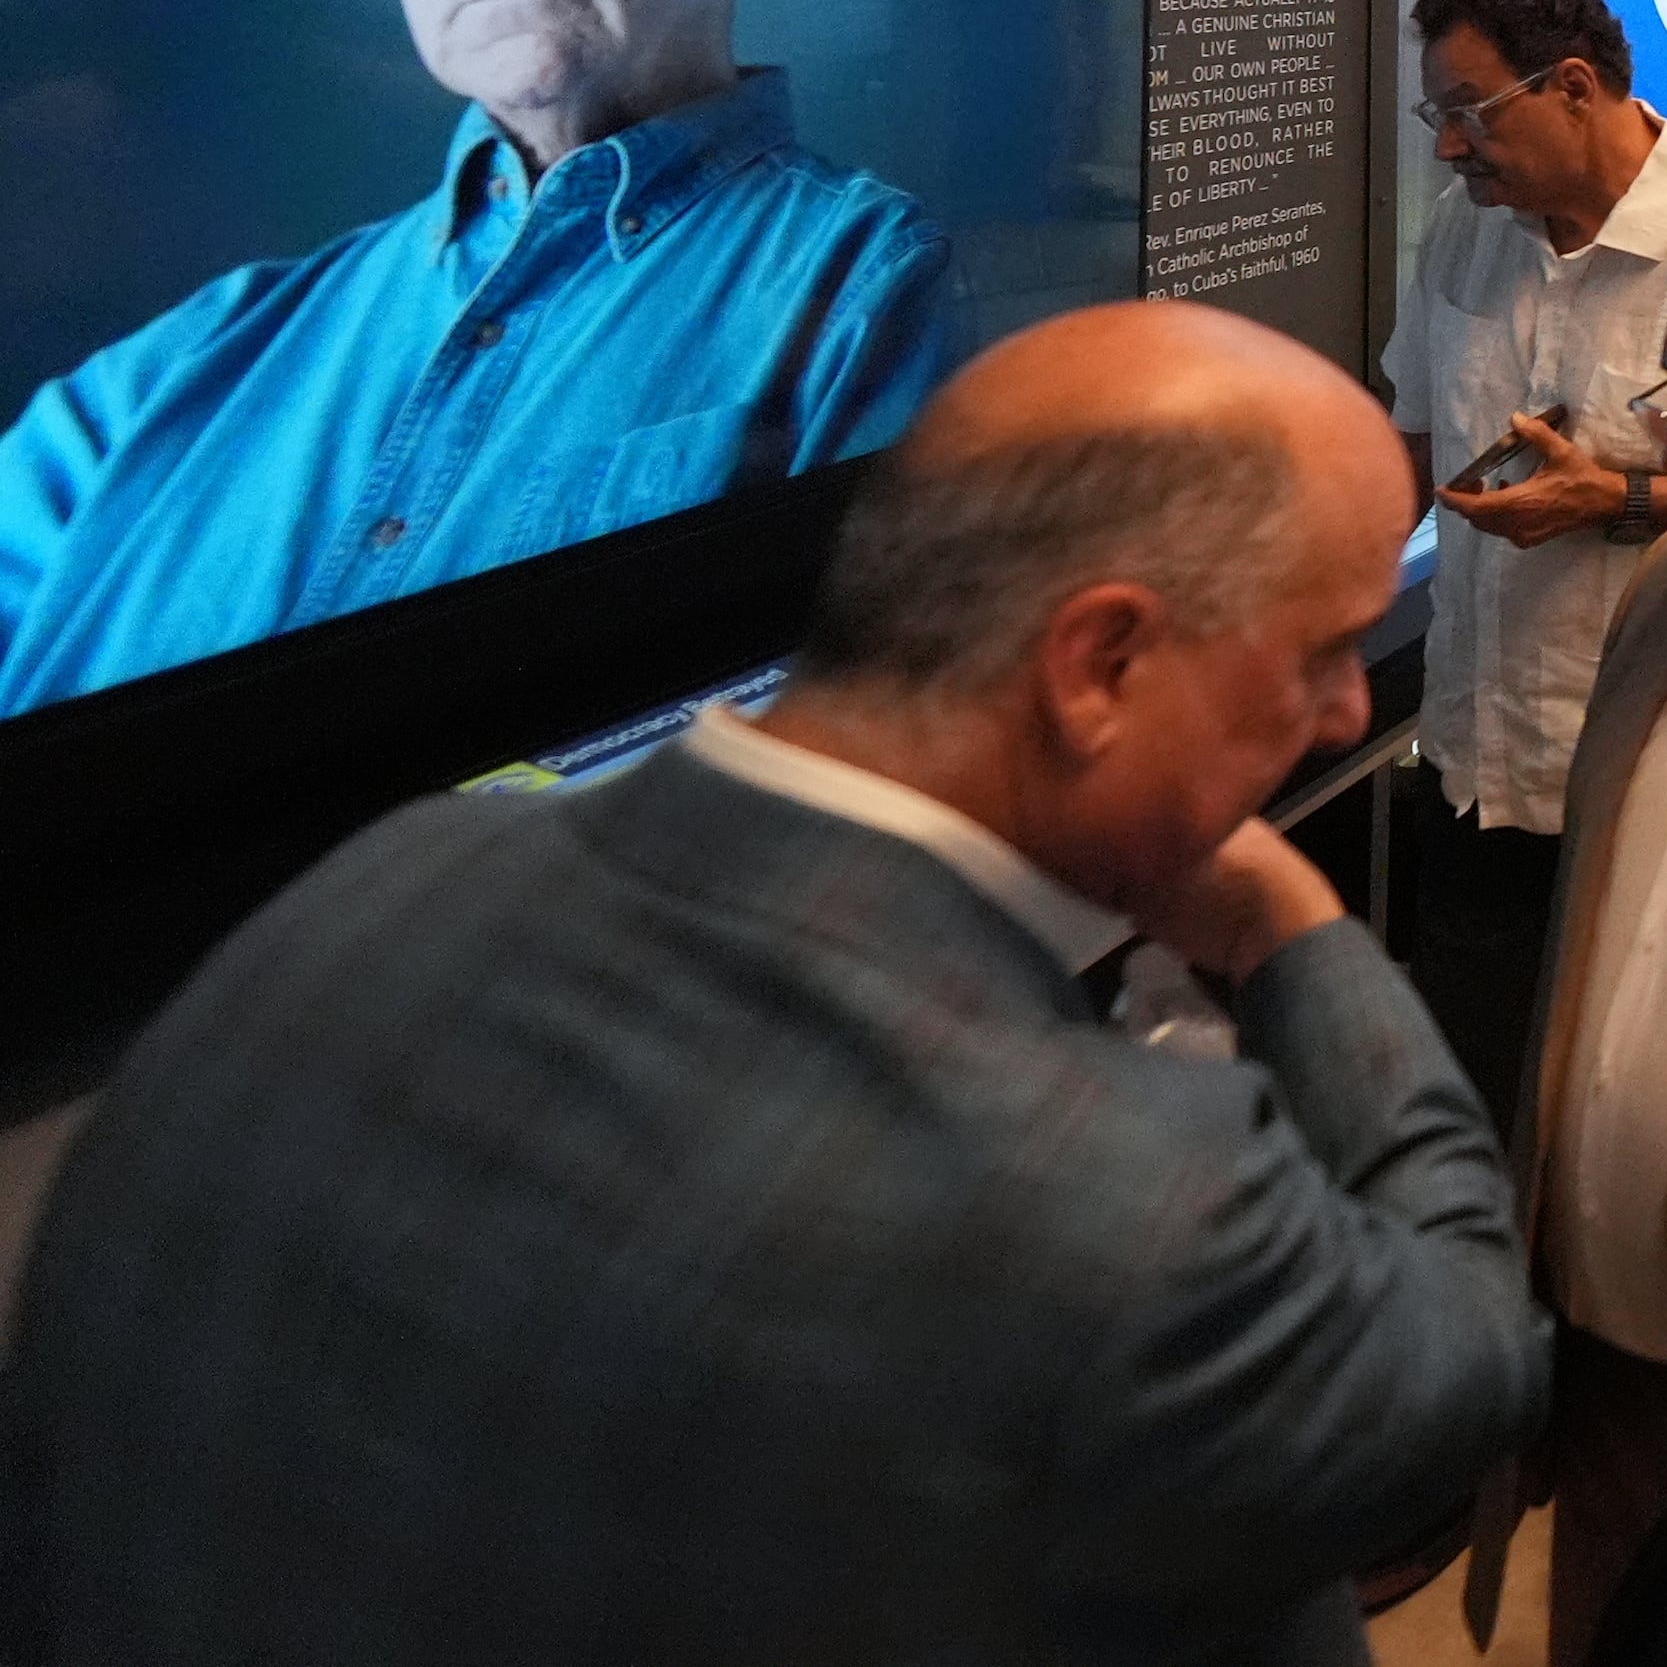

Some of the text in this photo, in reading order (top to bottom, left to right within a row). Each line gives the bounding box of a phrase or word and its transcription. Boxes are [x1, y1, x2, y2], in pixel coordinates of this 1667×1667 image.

[1175, 11, 1335, 35] A GENUINE CHRISTIAN
[1201, 32, 1336, 58] LIVE WITHOUT
[1193, 55, 1321, 83] OUR OWN PEOPLE
[1150, 76, 1335, 112] LWAYS THOUGHT IT BEST
[1180, 106, 1272, 133] EVERYTHING,
[1278, 102, 1312, 119] EVEN
[1318, 97, 1334, 112] TO
[1149, 120, 1334, 162] HEIR BLOOD, RATHER
[1165, 142, 1334, 184] TO RENOUNCE THE
[1169, 189, 1192, 208] OF
[1198, 177, 1257, 202] LIBERTY
[1175, 221, 1228, 245] Enrique
[1232, 213, 1268, 232] Perez
[1271, 200, 1326, 223] Serantes,
[1157, 248, 1215, 275] Catholic
[1218, 232, 1292, 261] Archbishop
[1295, 224, 1309, 242] of
[1173, 280, 1189, 298] to
[1291, 246, 1320, 267] 1960
